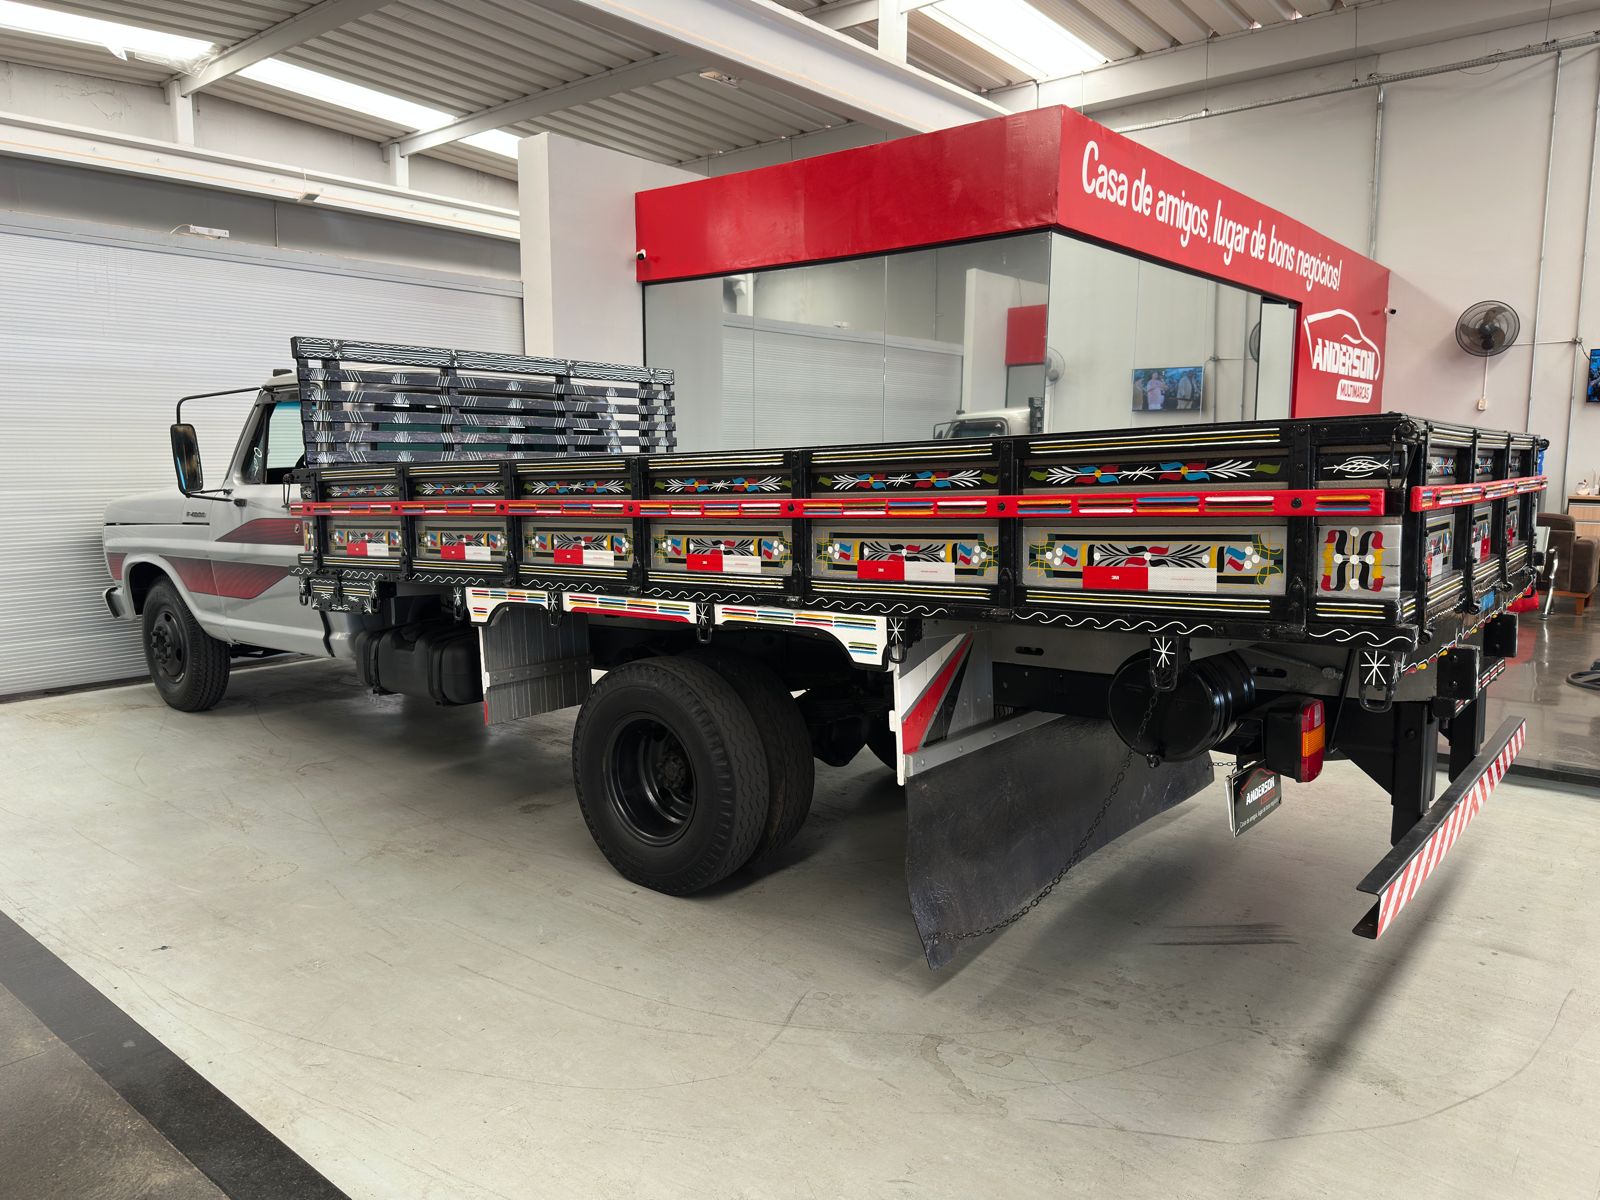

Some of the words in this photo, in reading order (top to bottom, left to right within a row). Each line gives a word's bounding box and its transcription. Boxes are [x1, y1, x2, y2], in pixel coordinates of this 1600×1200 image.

[1082, 140, 1128, 207] Casa
[1131, 167, 1153, 216] de
[1156, 190, 1211, 247] amigos,
[1213, 199, 1249, 266] lugar
[1250, 219, 1266, 260] de
[1268, 224, 1295, 271] bons
[1296, 249, 1342, 292] negócios!
[1312, 337, 1375, 380] ANDERSON
[1340, 382, 1370, 400] MULTIMARCAS
[1246, 776, 1275, 806] ANDERSON
